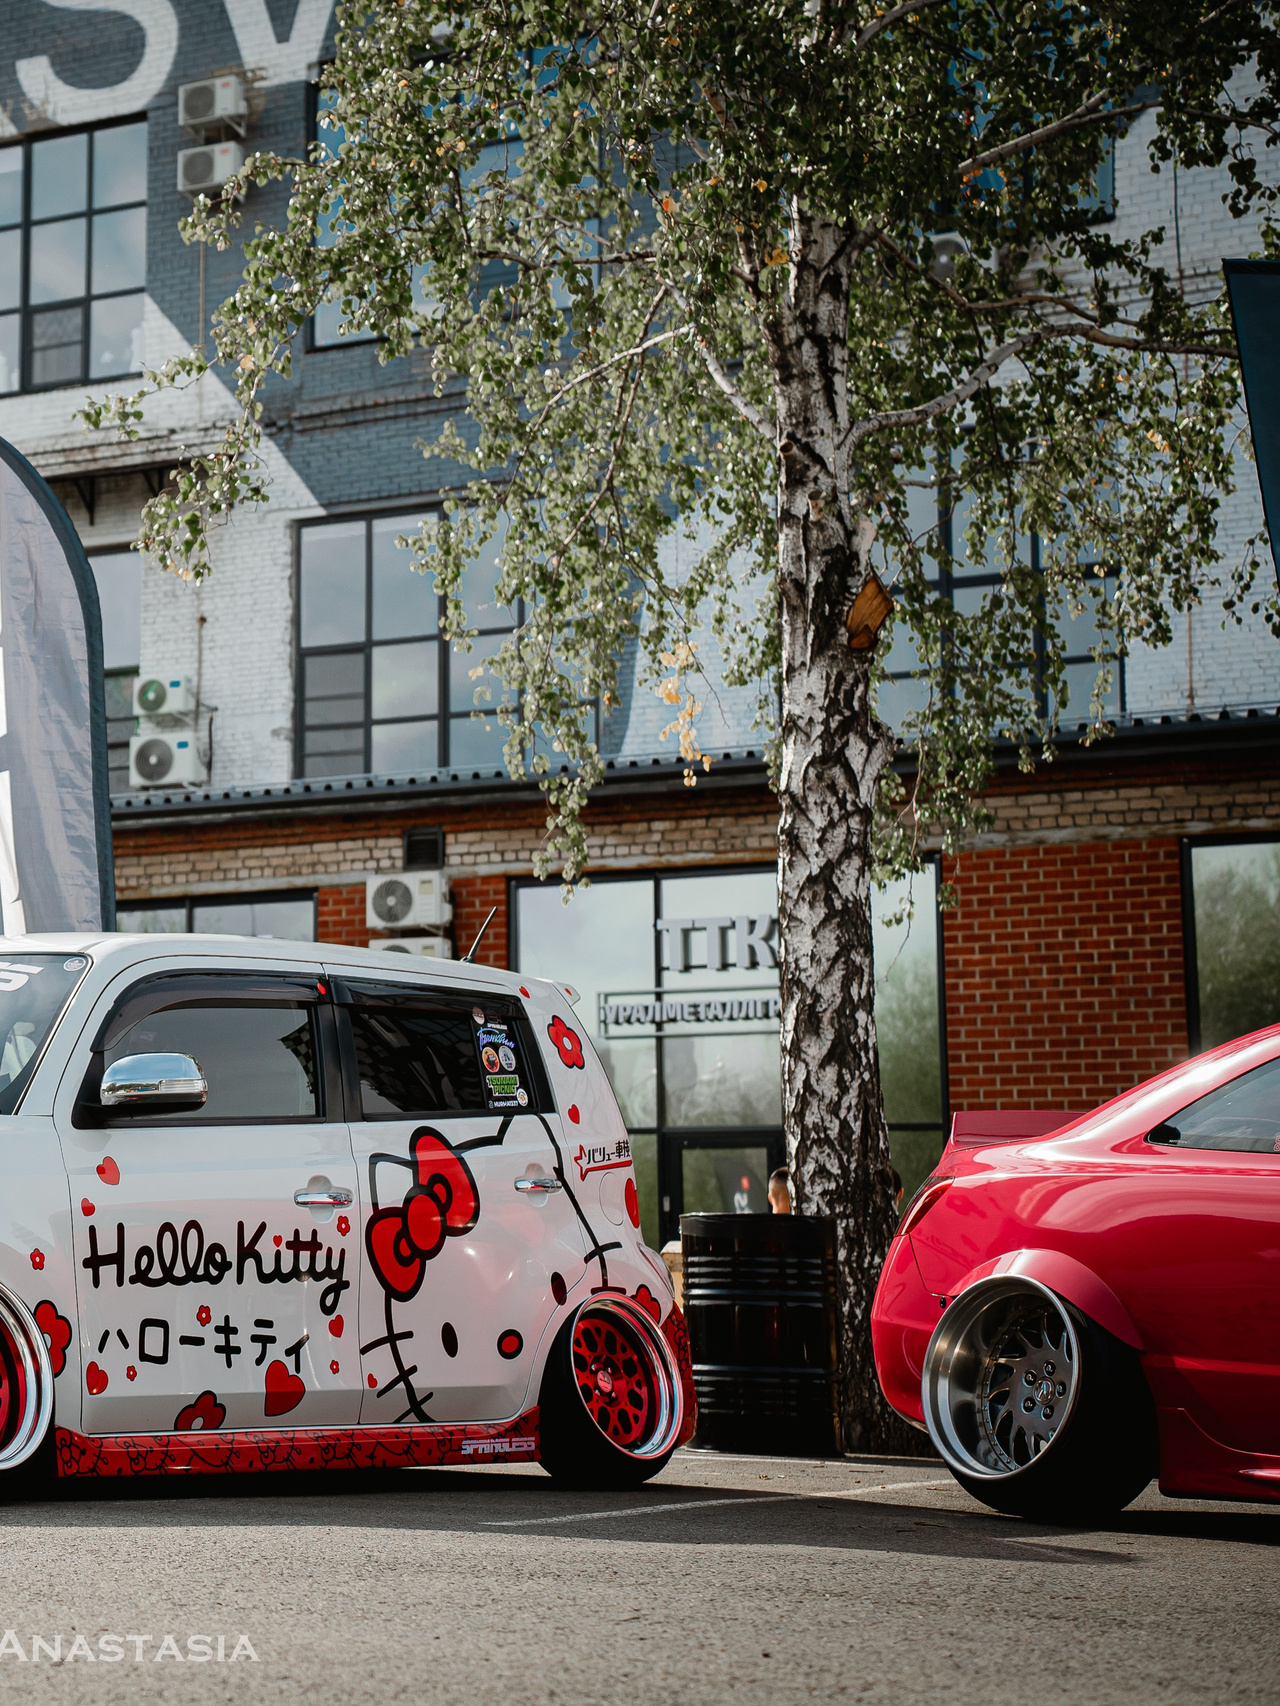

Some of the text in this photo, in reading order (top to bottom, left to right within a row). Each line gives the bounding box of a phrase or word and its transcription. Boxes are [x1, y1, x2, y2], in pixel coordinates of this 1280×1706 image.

[488, 1076, 518, 1085] TSUNAMI
[493, 1085, 516, 1094] PICNIC
[83, 1219, 350, 1316] Hello Kitty
[98, 1315, 310, 1374] ハローキティ
